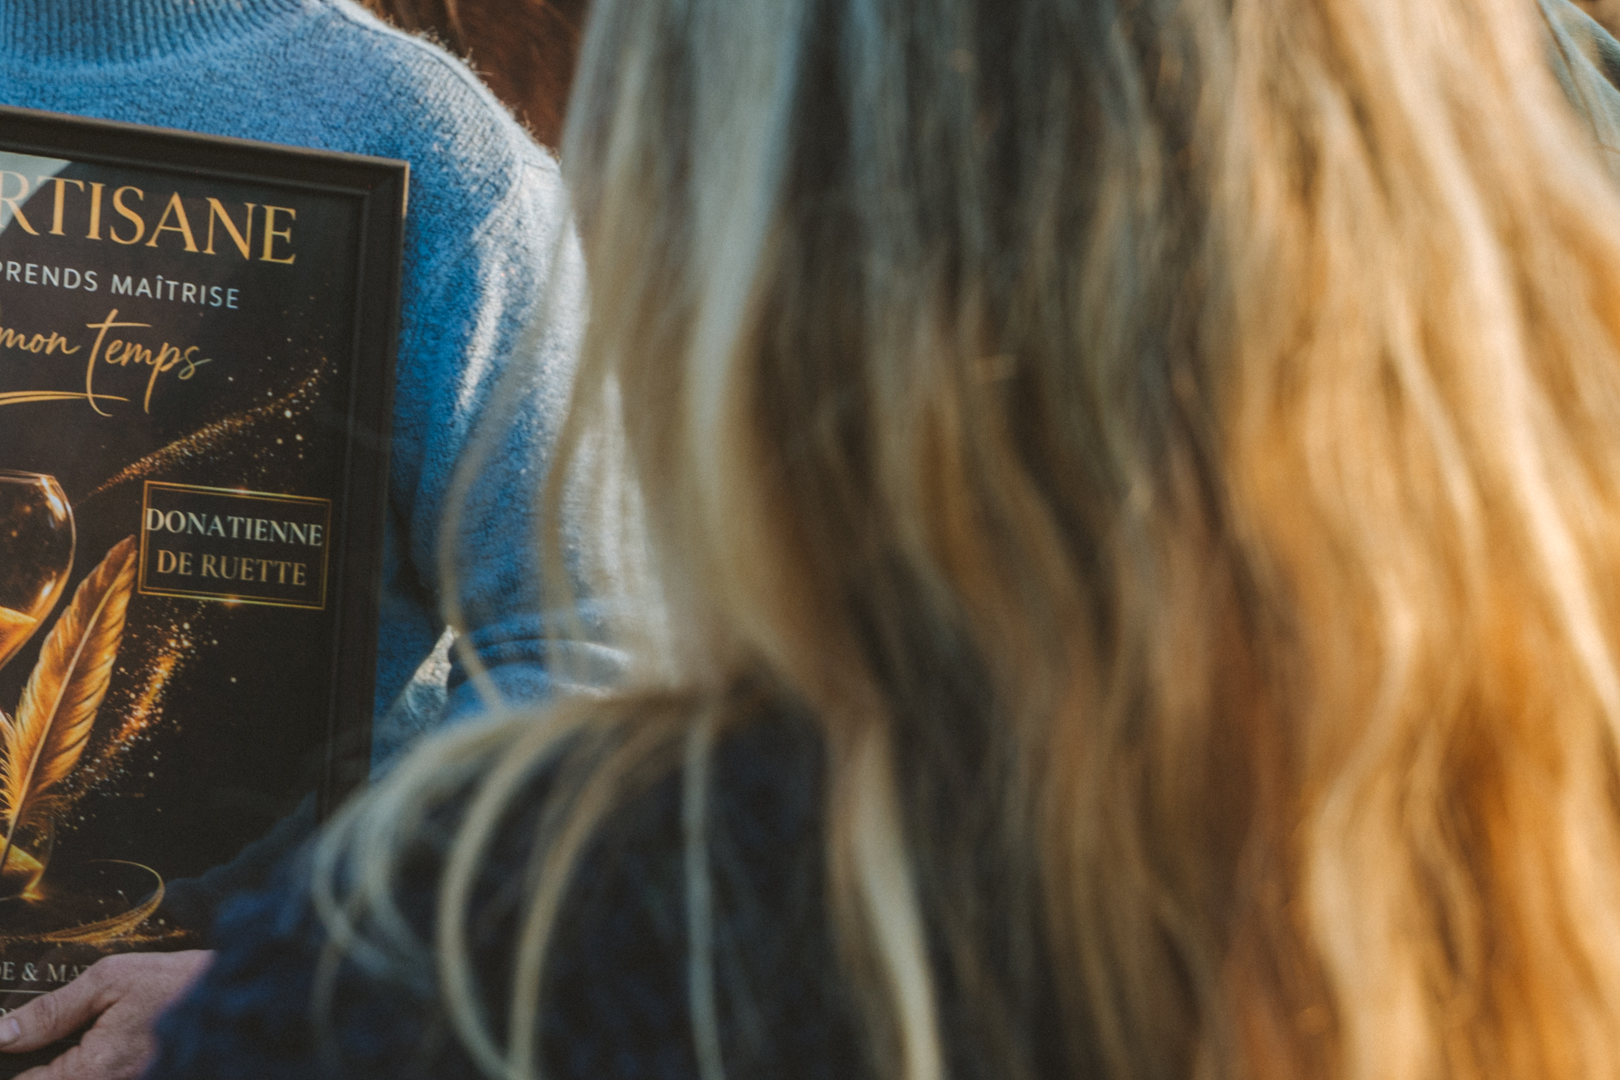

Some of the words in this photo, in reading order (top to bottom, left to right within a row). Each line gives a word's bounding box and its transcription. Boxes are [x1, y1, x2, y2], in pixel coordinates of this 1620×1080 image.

[110, 272, 240, 310] MAÎTRISE
[145, 507, 324, 548] DONATIENNE
[156, 548, 194, 576] DE
[200, 553, 308, 587] RUETTE
[21, 961, 39, 982] &
[45, 962, 91, 984] MA
